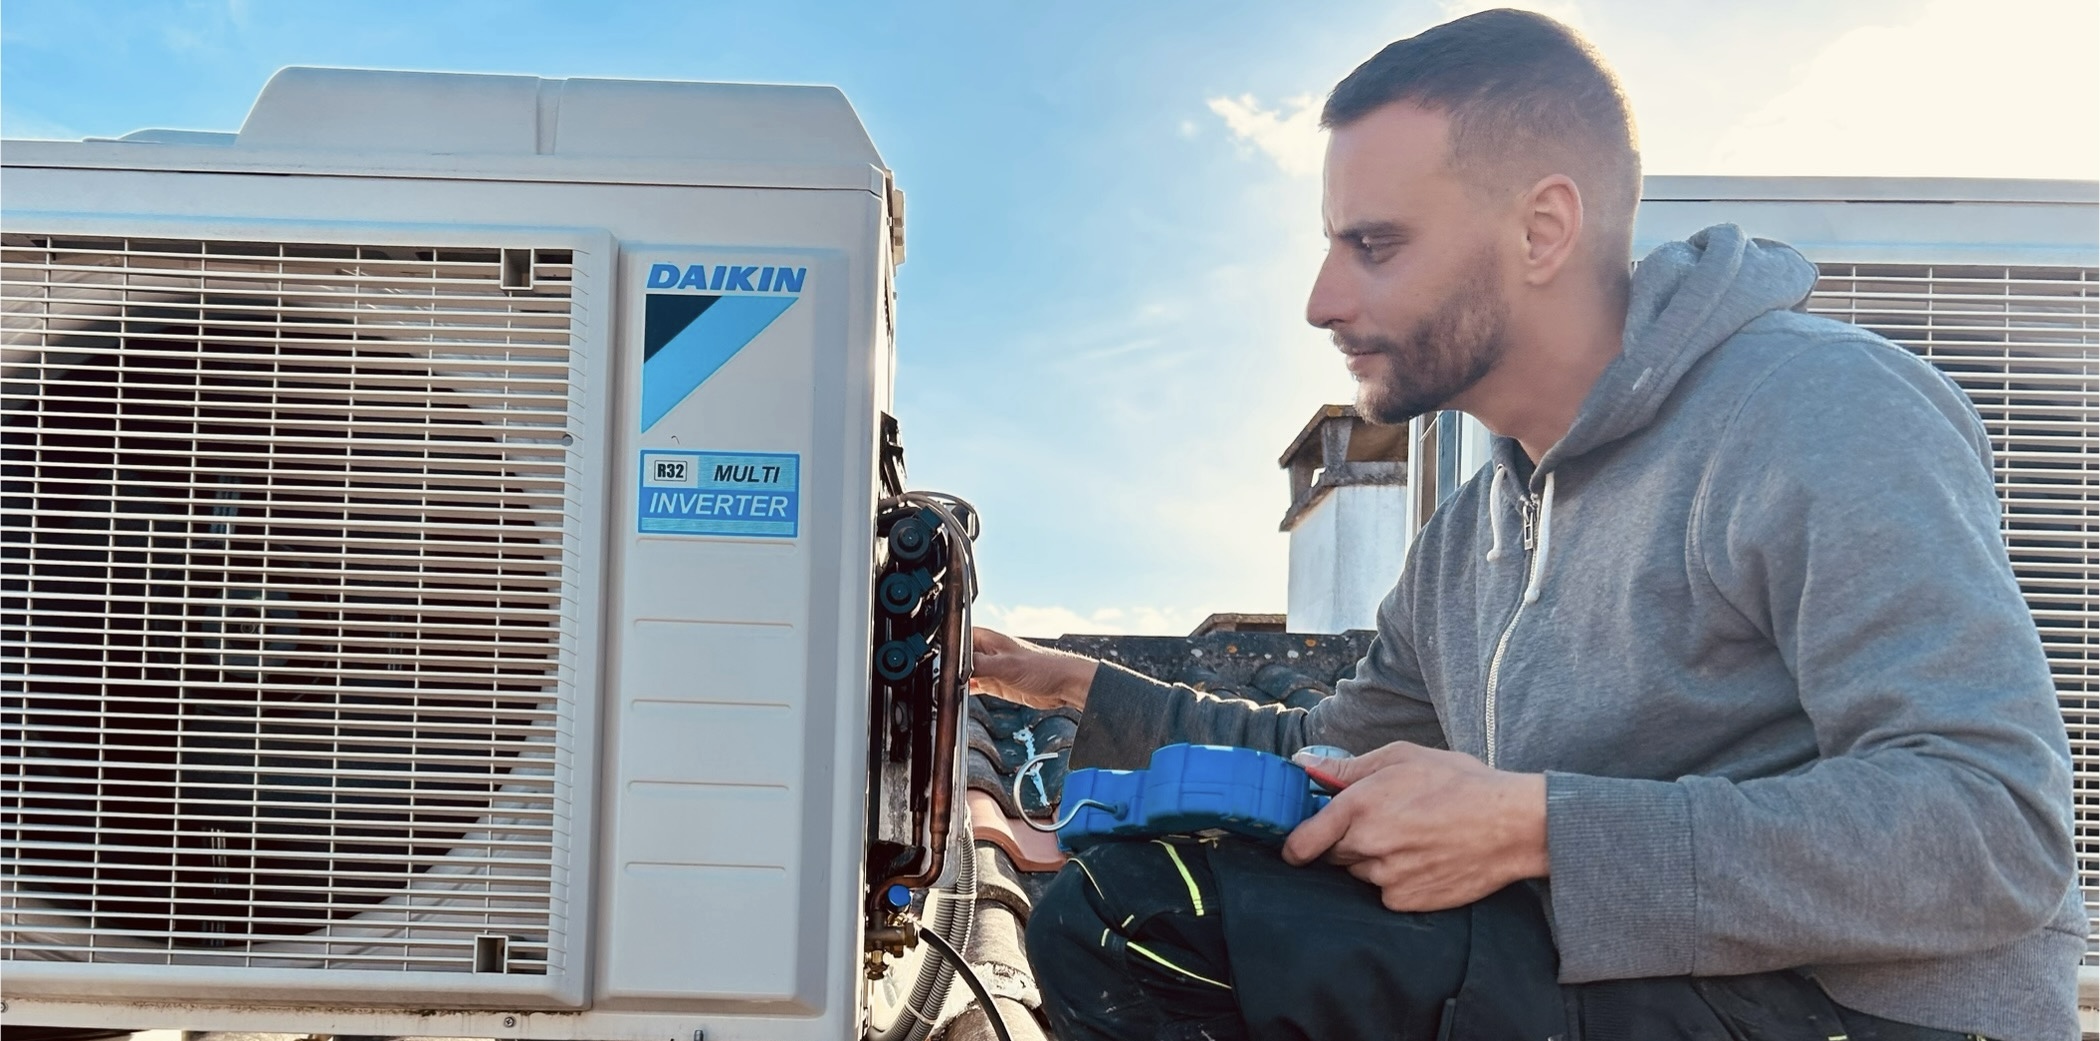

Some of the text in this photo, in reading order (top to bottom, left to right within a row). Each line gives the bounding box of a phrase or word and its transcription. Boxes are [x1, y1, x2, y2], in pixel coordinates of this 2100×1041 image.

[646, 263, 807, 293] DAIKIN
[657, 463, 780, 483] R32 MULTI
[649, 492, 788, 518] INVERTER
